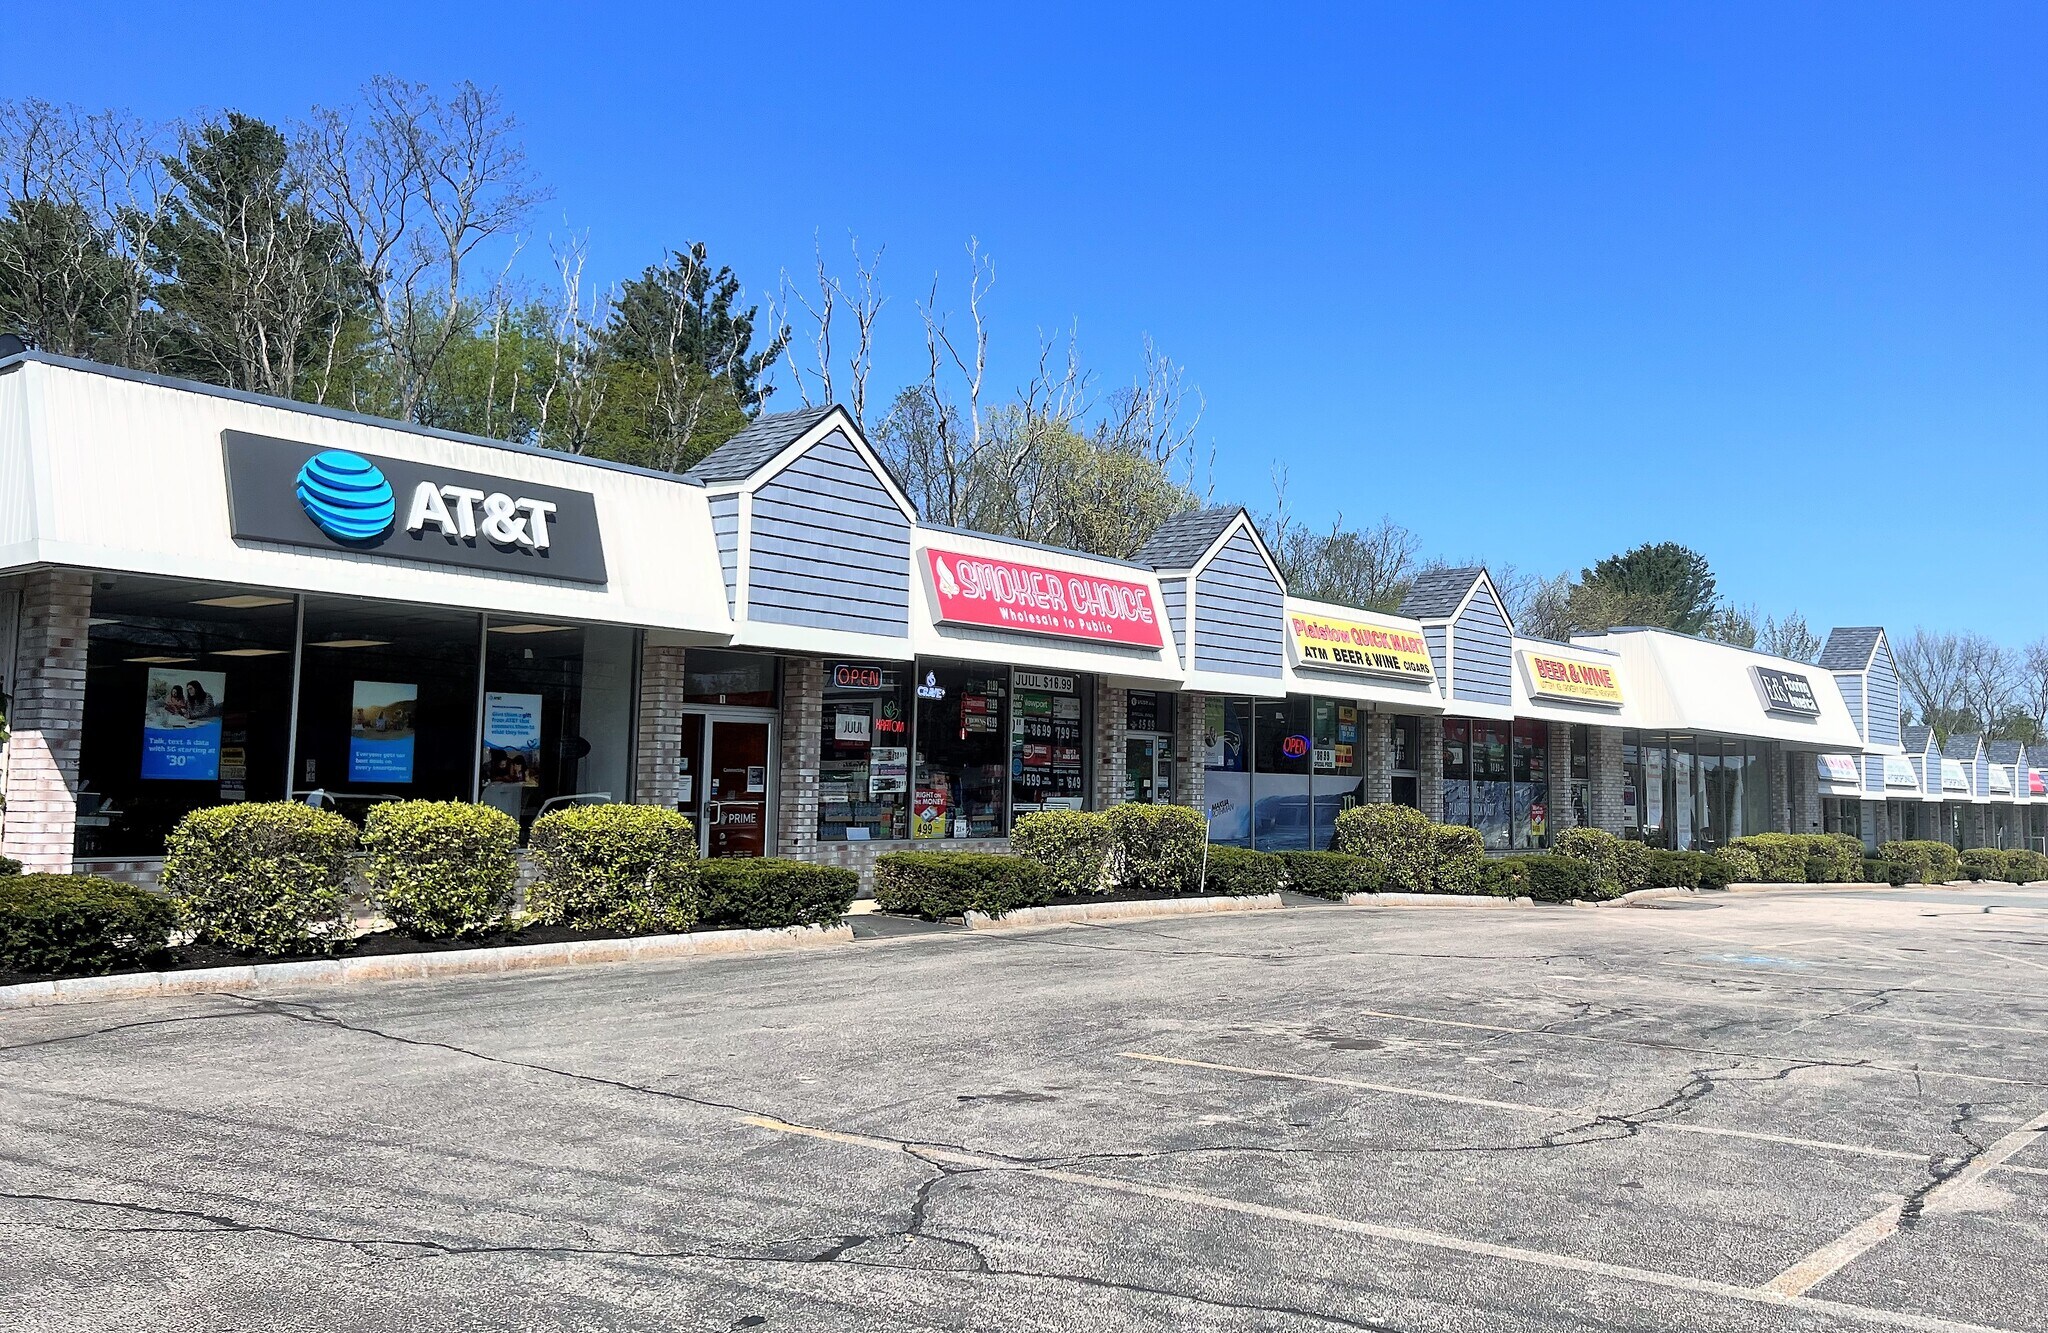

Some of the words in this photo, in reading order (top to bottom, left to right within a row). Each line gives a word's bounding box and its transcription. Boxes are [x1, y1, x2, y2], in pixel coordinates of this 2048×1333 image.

[406, 480, 557, 550] AT&T
[956, 559, 1068, 612] SMOKER
[1068, 577, 1154, 624] CHOICE
[998, 607, 1060, 627] Wholesale
[1064, 615, 1075, 629] to
[1079, 617, 1113, 634] Public
[1292, 618, 1350, 644] Plaistow
[1350, 627, 1392, 650] QUICK
[1389, 634, 1426, 655] MART
[1304, 645, 1328, 660] ATM
[1332, 647, 1364, 665] BEER
[1364, 652, 1373, 667] &
[1372, 653, 1401, 670] WINE
[1403, 661, 1430, 674] CIGARS
[838, 667, 879, 687] OPEN
[1015, 674, 1041, 687] JUUL
[1043, 676, 1072, 691] $16.99
[1534, 657, 1570, 683] BEER
[1568, 663, 1582, 684] &
[1578, 665, 1614, 689] WINE
[1761, 675, 1789, 703] Ed's
[1781, 675, 1812, 698] Flooring
[1787, 692, 1818, 711] America
[843, 720, 863, 734] JUUL
[1284, 737, 1307, 755] OPEN
[728, 812, 757, 824] PRIME
